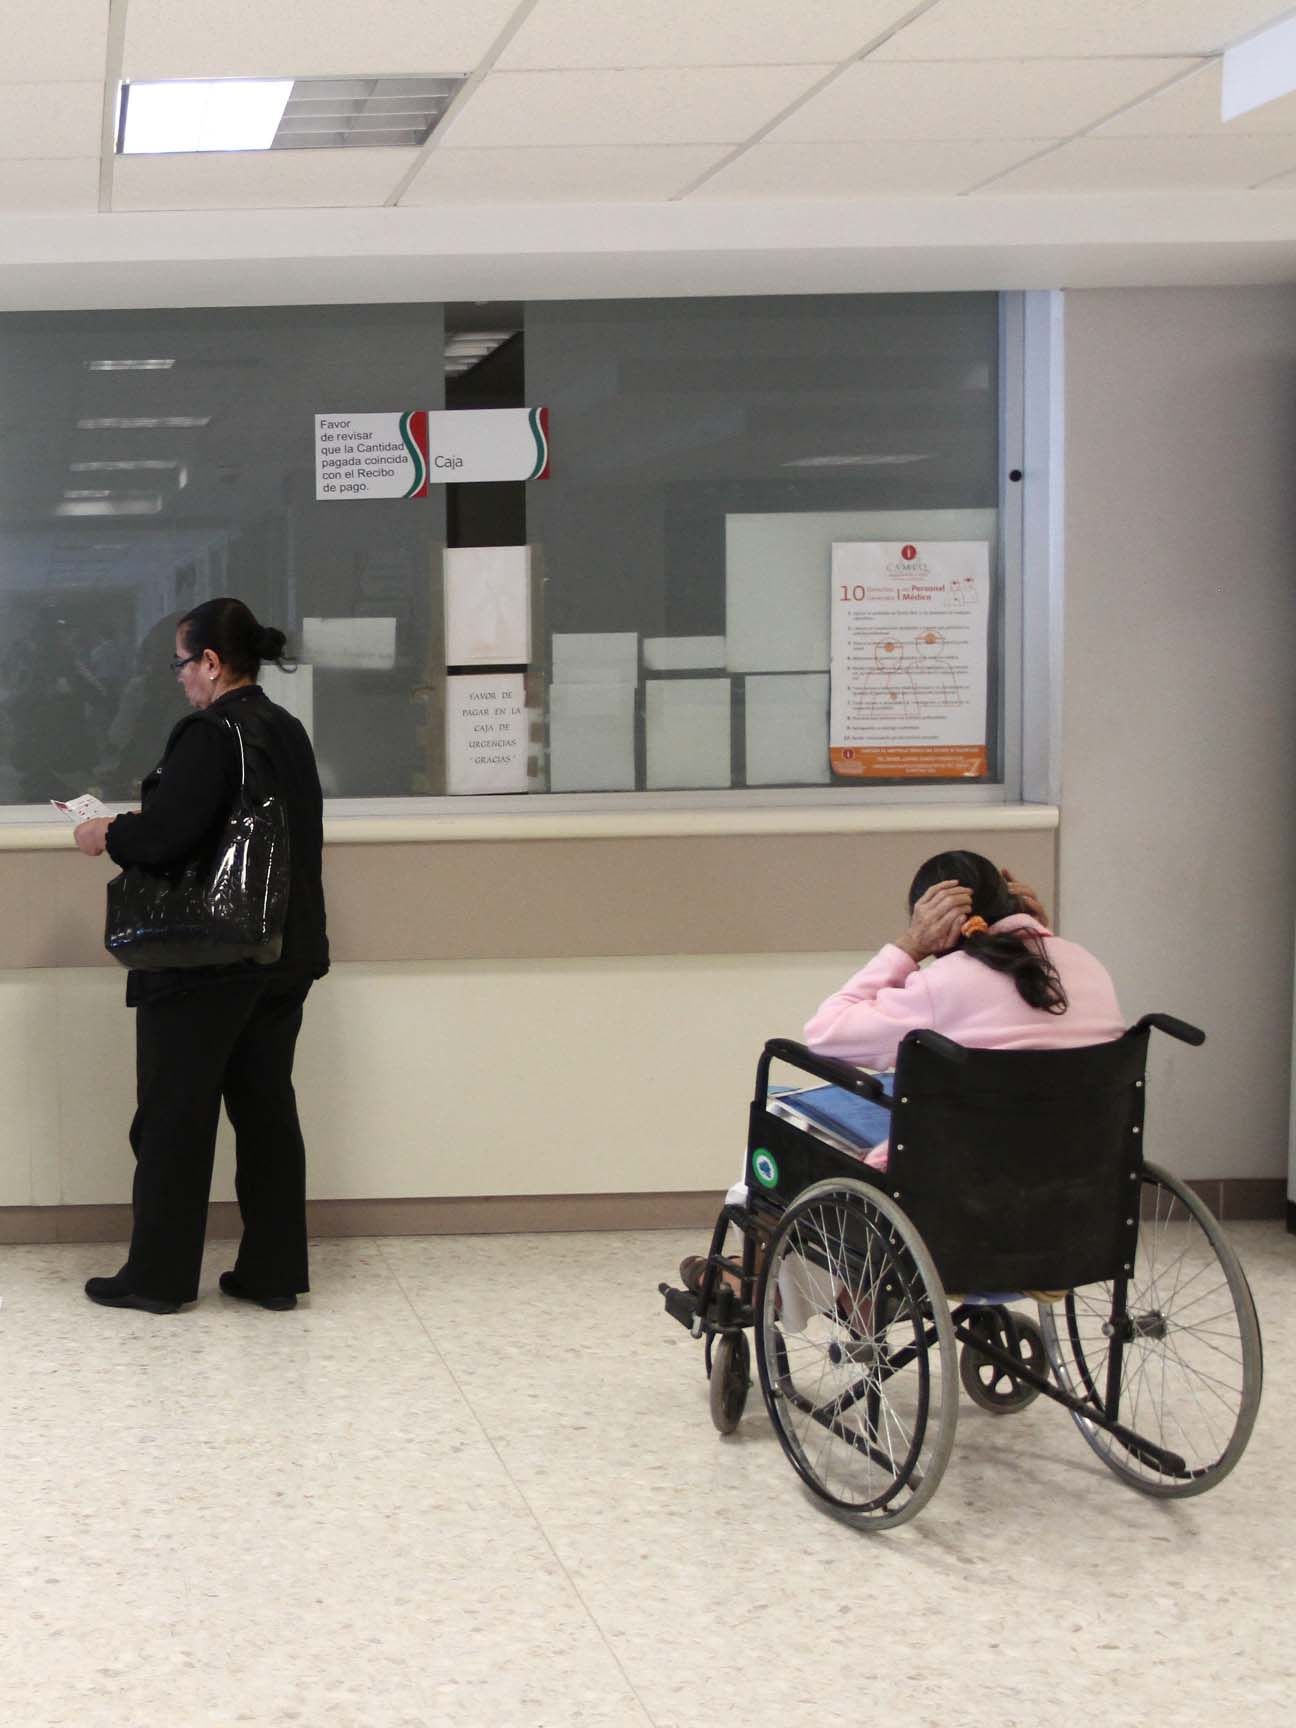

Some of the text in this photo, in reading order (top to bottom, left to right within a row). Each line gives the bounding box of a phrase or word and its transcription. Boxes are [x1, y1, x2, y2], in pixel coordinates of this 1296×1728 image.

[320, 420, 351, 429] Favor
[320, 432, 373, 442] de revisar
[321, 442, 404, 456] que la Cantidad
[322, 454, 408, 469] pagada coincida
[434, 456, 463, 470] Caja
[322, 468, 394, 480] con el Recibo
[323, 482, 368, 494] de pago.
[840, 585, 865, 601] 10
[912, 584, 945, 592] Personal
[903, 592, 931, 600] Médico
[469, 691, 512, 700] FAVOR DE
[462, 707, 521, 717] PAGAR EN LA
[474, 724, 511, 733] CAJA DE
[468, 740, 516, 749] URGENCIAS
